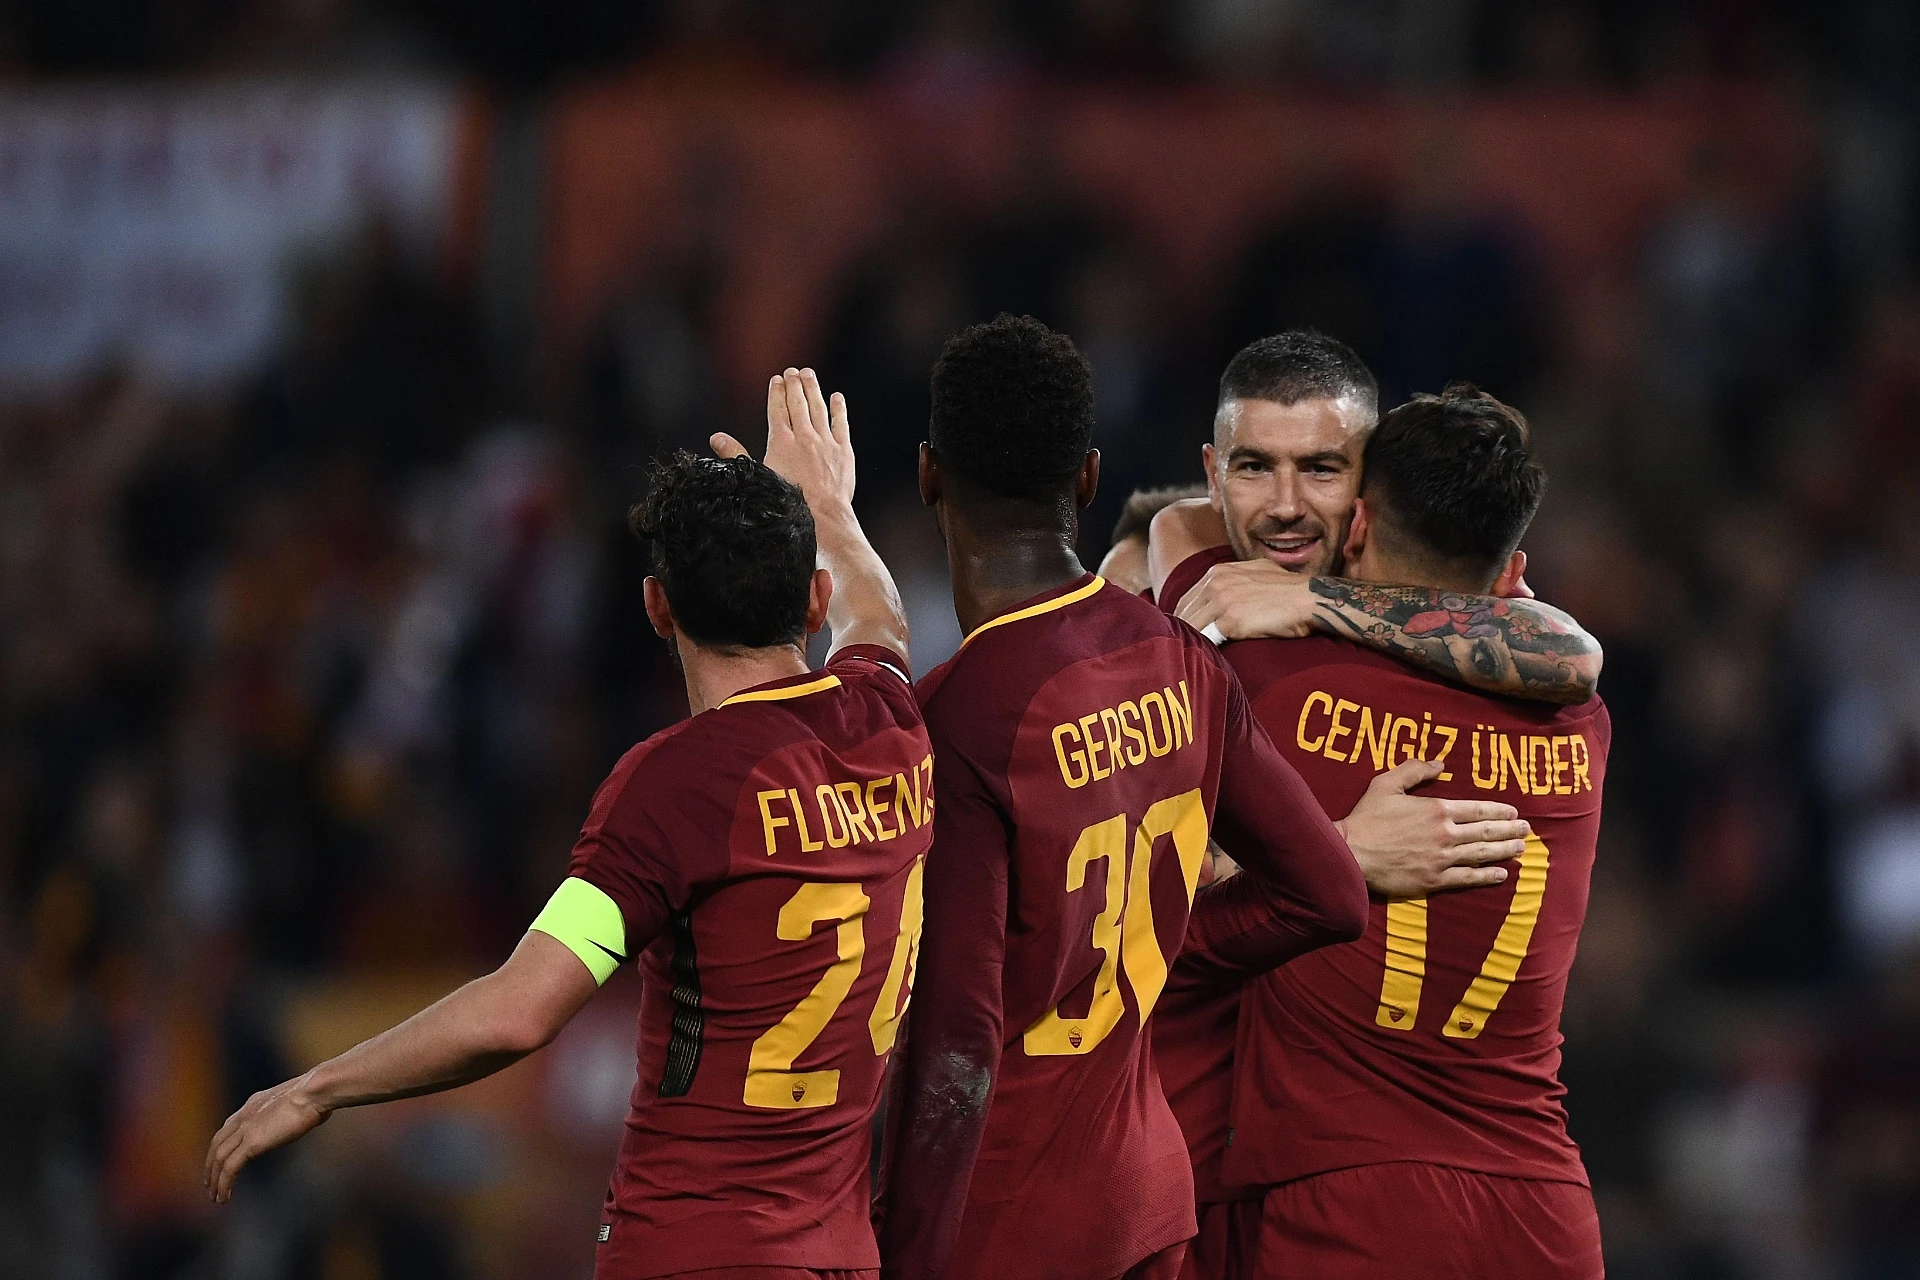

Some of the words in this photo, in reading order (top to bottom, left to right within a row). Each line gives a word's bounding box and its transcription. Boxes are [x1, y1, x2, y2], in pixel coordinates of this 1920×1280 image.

[1051, 680, 1194, 789] GERSON
[1471, 723, 1593, 796] ÜNDER
[1022, 788, 1209, 1056] 30
